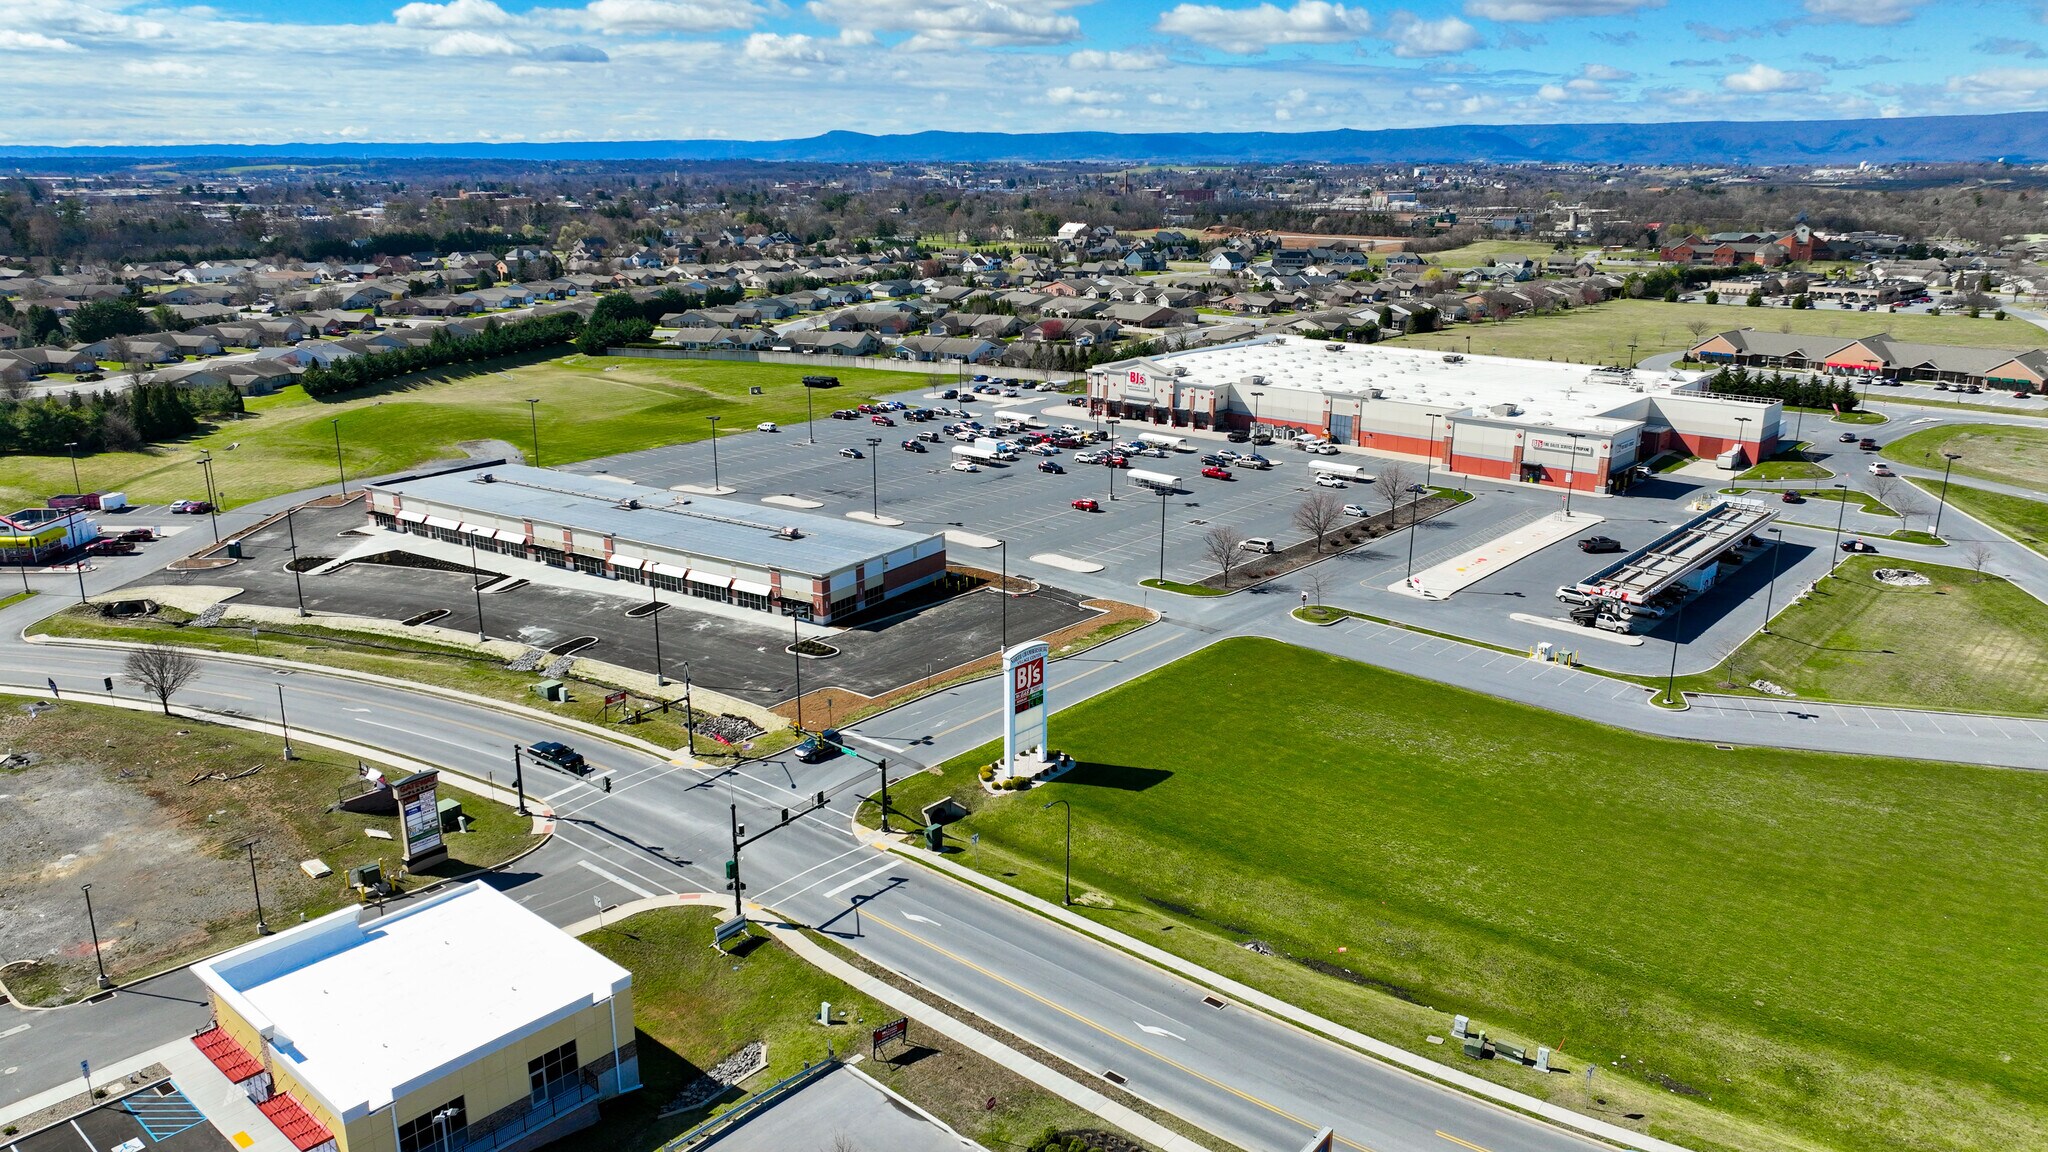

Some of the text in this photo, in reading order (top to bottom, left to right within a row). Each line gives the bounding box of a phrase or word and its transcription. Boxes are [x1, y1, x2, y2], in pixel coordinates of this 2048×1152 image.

[1130, 371, 1145, 385] BJ's
[1603, 589, 1623, 599] GAS
[1017, 660, 1041, 690] BJ's
[400, 775, 436, 793] GATEWAY
[407, 785, 430, 795] PLAZA
